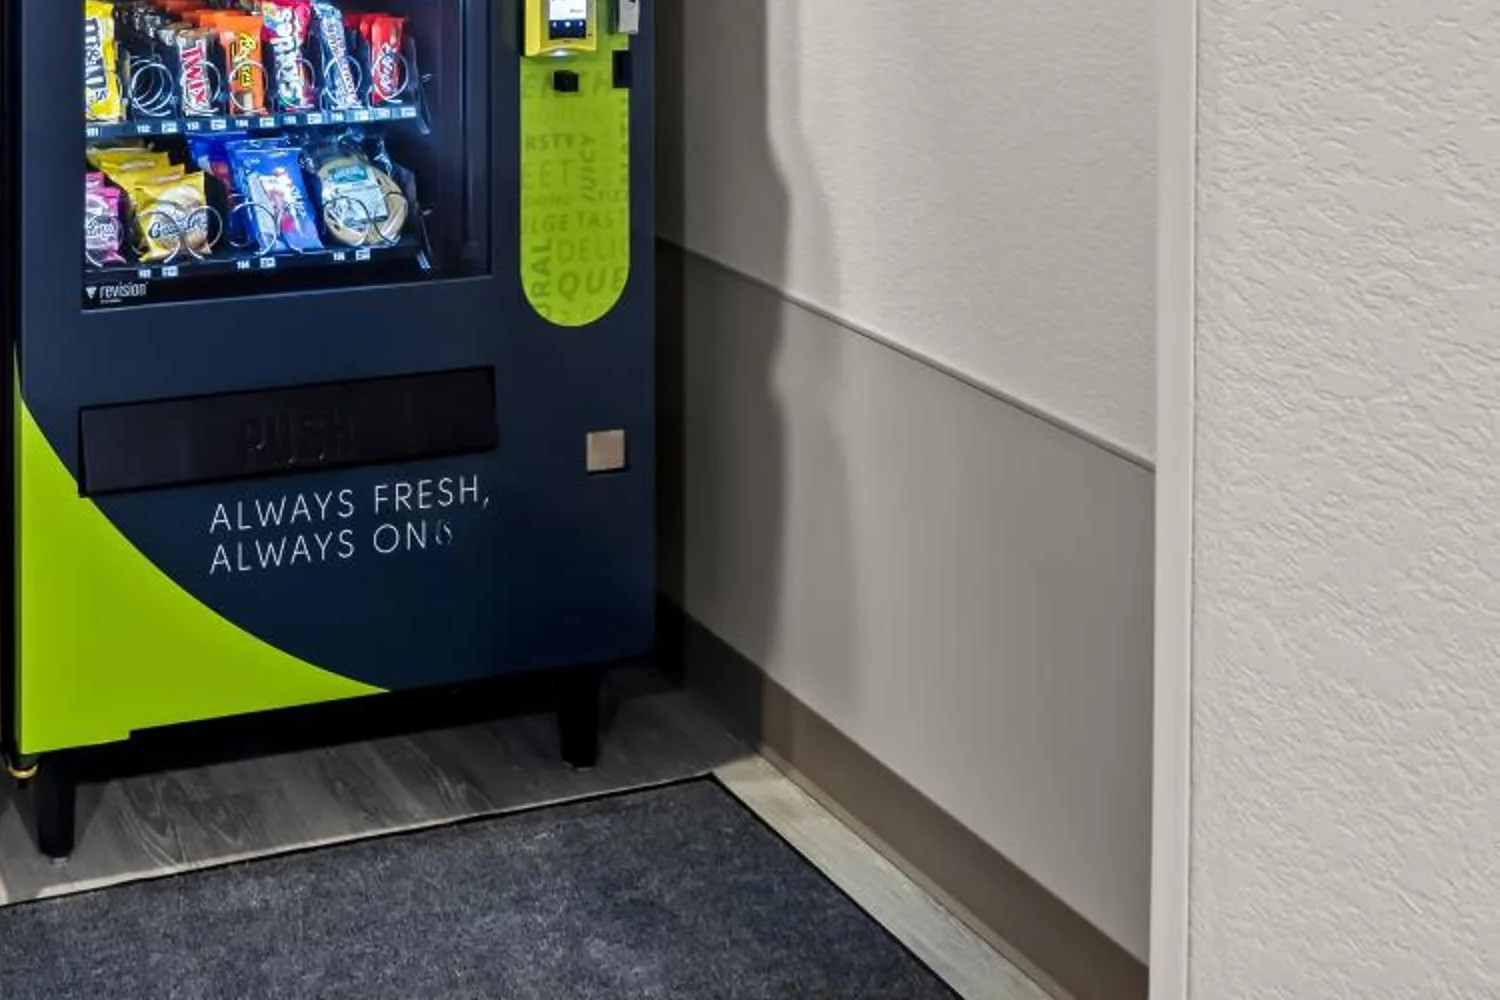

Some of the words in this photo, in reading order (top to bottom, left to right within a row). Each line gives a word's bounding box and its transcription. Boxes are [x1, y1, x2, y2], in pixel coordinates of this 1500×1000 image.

[182, 45, 206, 104] TWIX
[100, 282, 146, 299] revision
[209, 489, 355, 534] ALWAYS
[374, 474, 489, 515] FRESH,
[209, 529, 355, 575] ALWAYS
